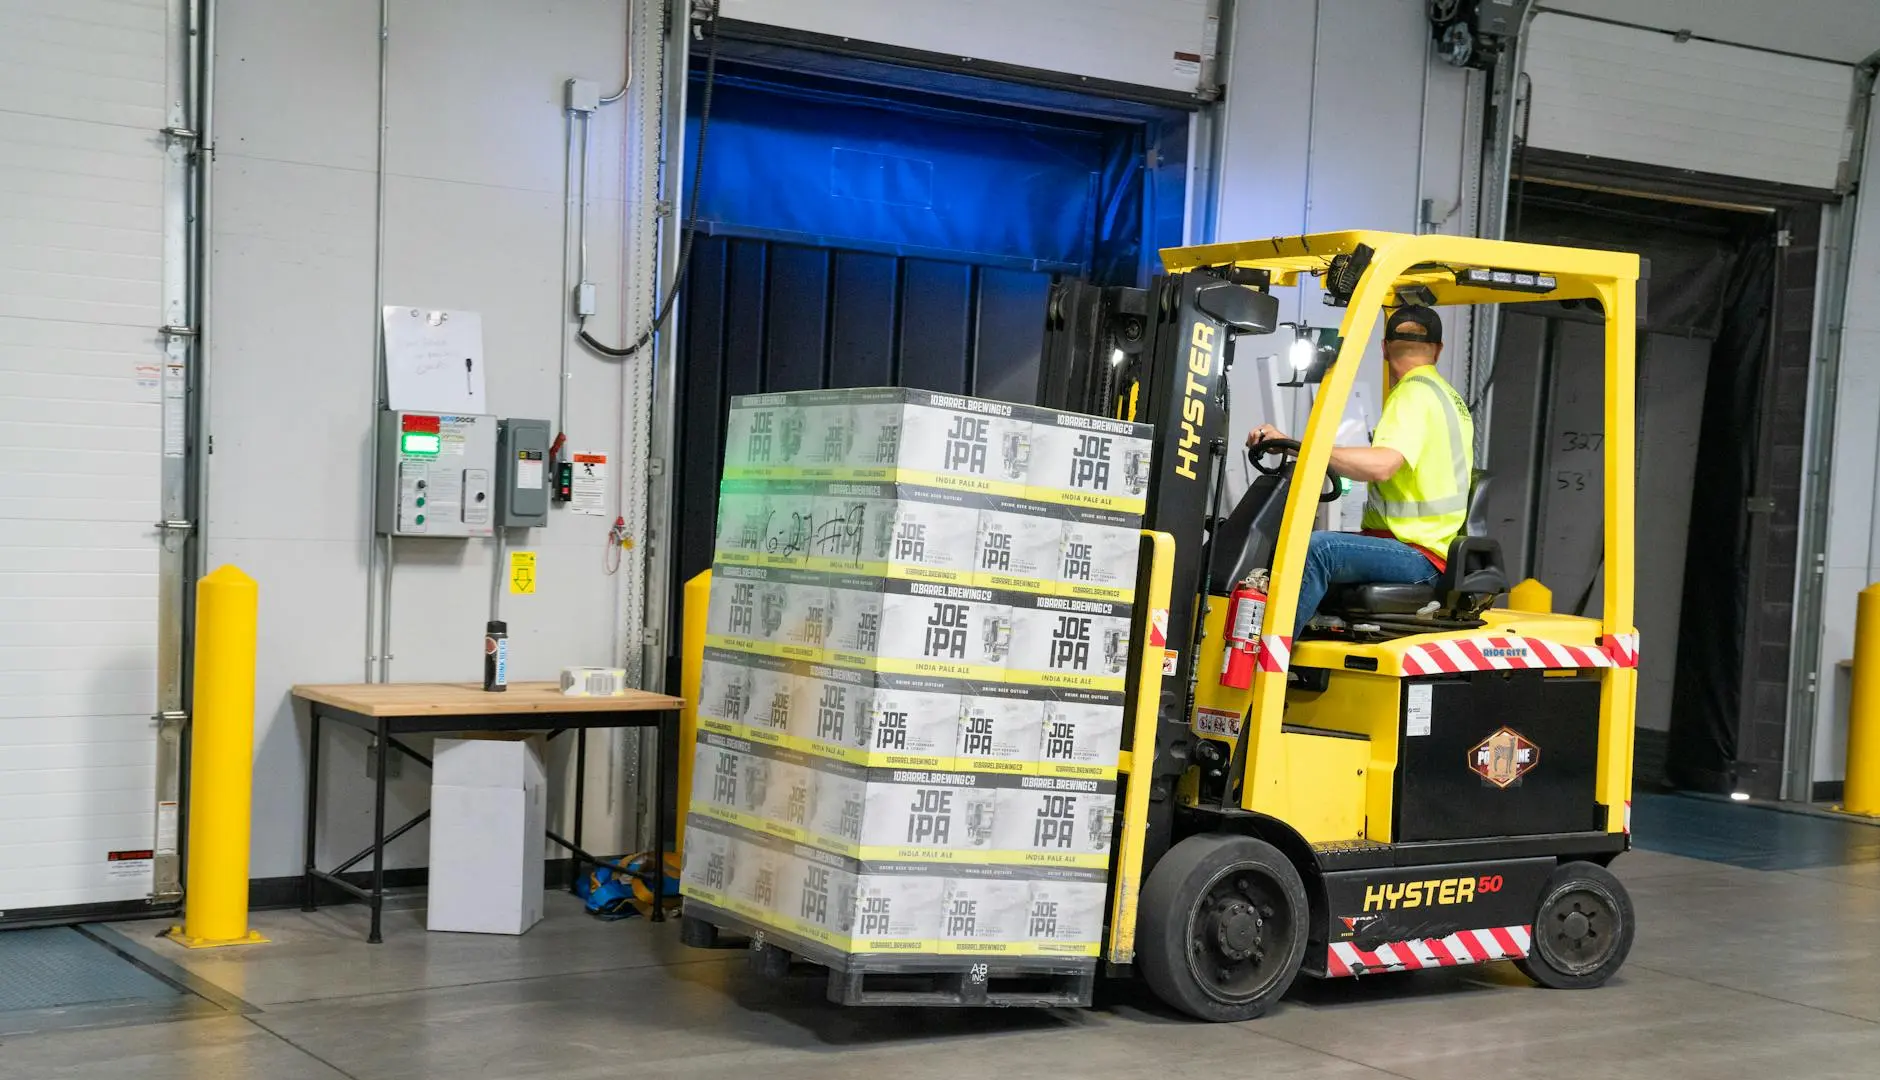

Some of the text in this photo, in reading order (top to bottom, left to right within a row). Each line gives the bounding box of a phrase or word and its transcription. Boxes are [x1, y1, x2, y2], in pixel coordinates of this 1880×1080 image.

[1175, 321, 1215, 481] HYSTER
[750, 412, 774, 434] JOE
[947, 415, 990, 443] JOE
[748, 434, 772, 462] IPA
[944, 440, 987, 474] IPA
[1073, 434, 1112, 460] JOE
[935, 475, 989, 490] INDIA PALE ALE
[1070, 458, 1110, 490] IPA
[1062, 493, 1081, 501] INDIA
[1083, 496, 1098, 504] PALE
[897, 522, 926, 541] JOE
[984, 532, 1012, 550] JOE
[895, 539, 925, 561] IPA
[981, 548, 1010, 571] IPA
[1066, 542, 1092, 560] JOE
[1063, 558, 1091, 581] IPA
[731, 583, 754, 605] JOE
[728, 605, 752, 634] IPA
[805, 606, 824, 623] JOE
[858, 613, 878, 630] JOE
[928, 602, 970, 628] JOE
[803, 622, 822, 645] IPA
[1053, 616, 1092, 641] JOE
[856, 630, 877, 652] IPA
[924, 627, 967, 659] IPA
[1049, 640, 1089, 670] IPA
[1483, 648, 1527, 657] RIDE RITE
[915, 663, 936, 671] INDIA
[938, 665, 955, 673] PALE
[1041, 674, 1061, 682] INDIA
[1063, 675, 1079, 683] PALE
[771, 692, 790, 709] JOE
[819, 684, 846, 711] JOE
[769, 708, 788, 730] IPA
[816, 709, 844, 741] IPA
[879, 711, 908, 728] JOE
[966, 718, 994, 735] JOE
[876, 729, 906, 750] IPA
[1049, 722, 1075, 739] JOE
[963, 734, 992, 755] IPA
[1046, 739, 1073, 759] IPA
[715, 752, 738, 777] JOE
[713, 774, 737, 806] IPA
[910, 789, 953, 813] JOE
[1037, 795, 1077, 819] JOE
[907, 814, 950, 844] IPA
[1033, 819, 1074, 848] IPA
[803, 865, 830, 893] JOE
[1363, 875, 1503, 912] HYSTER 50
[801, 890, 828, 924] IPA
[862, 897, 891, 914] JOE
[949, 900, 977, 916] JOE
[1031, 902, 1058, 918] JOE
[860, 914, 889, 935] IPA
[947, 917, 976, 936] IPA
[1029, 918, 1057, 938] IPA
